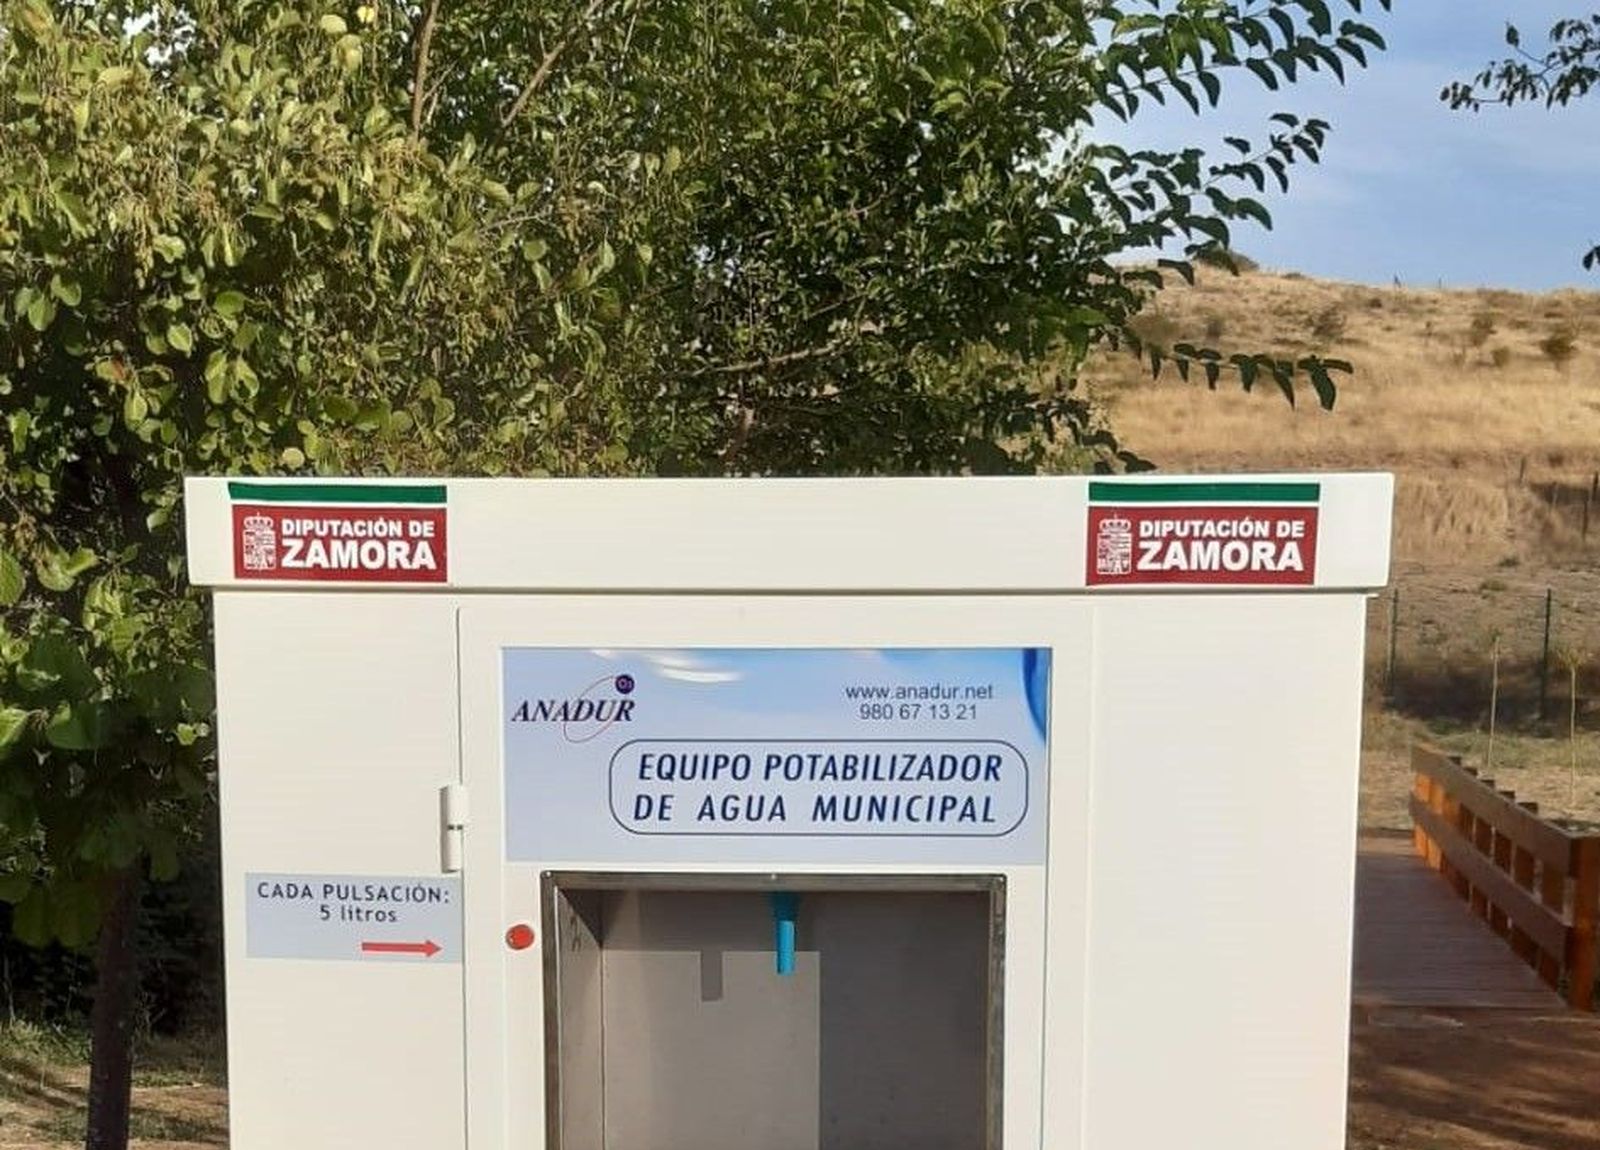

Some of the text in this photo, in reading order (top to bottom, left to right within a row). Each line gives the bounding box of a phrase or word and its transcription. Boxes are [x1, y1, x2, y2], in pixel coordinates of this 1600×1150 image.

[281, 517, 434, 538] DIPUTACIÓN DE
[1139, 517, 1304, 538] DIPUTACIÓN DE
[281, 539, 437, 570] ZAMORA
[1137, 541, 1304, 571] ZAMORA
[845, 684, 993, 700] www.anadur.net
[511, 698, 636, 723] ANADUR
[859, 704, 977, 720] 980 67 13 21
[639, 753, 1003, 783] EQUIPO POTABILIZADOR
[634, 794, 998, 824] DE AGUA MUNICIPAL
[257, 882, 449, 904] CADA PULSACIÓN:
[320, 905, 398, 922] 5 litros
